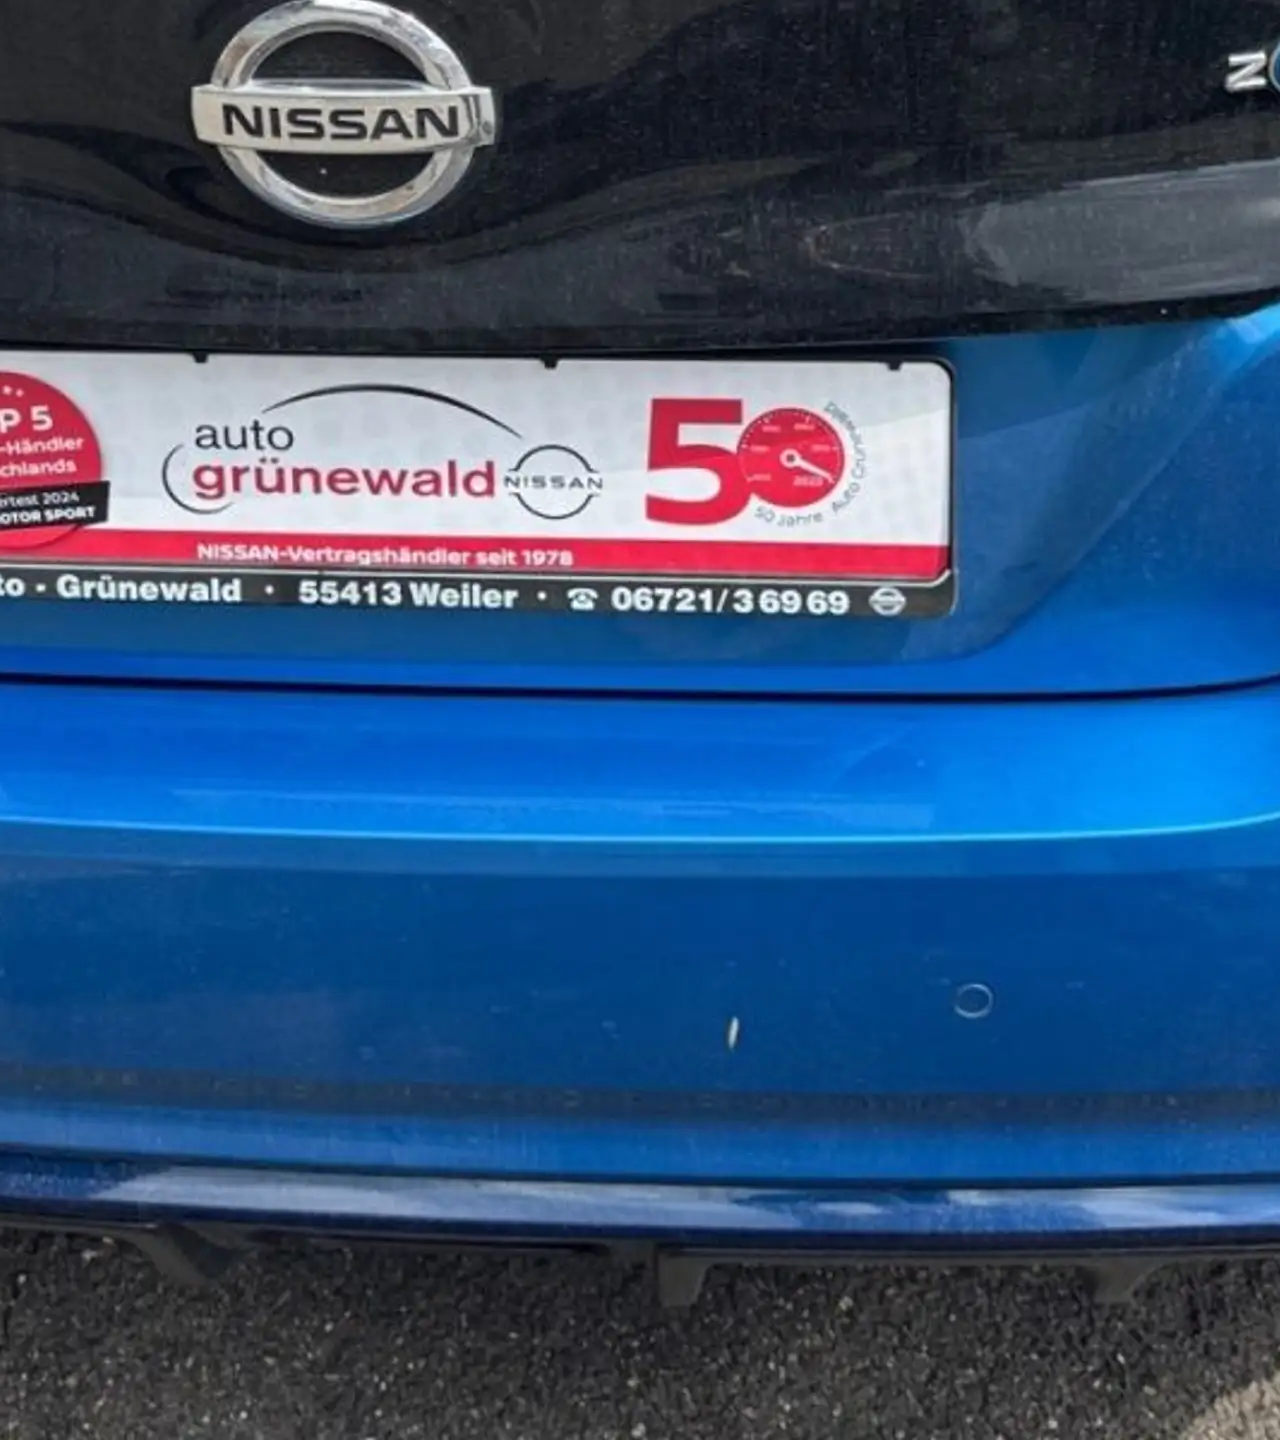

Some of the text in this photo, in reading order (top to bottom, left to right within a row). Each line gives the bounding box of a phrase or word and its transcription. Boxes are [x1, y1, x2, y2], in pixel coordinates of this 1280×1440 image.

[222, 104, 459, 141] NISSAN
[30, 405, 54, 431] 5
[195, 419, 294, 452] auto
[192, 459, 496, 501] grünewald
[504, 474, 603, 491] NISSAN
[42, 490, 80, 506] 2024
[45, 505, 96, 521] SPORT
[197, 542, 574, 568] NISSAN-Vertragshändler seit 1978
[55, 573, 243, 603] Grünewald
[299, 579, 403, 606] 55413
[409, 582, 519, 609] Weiler
